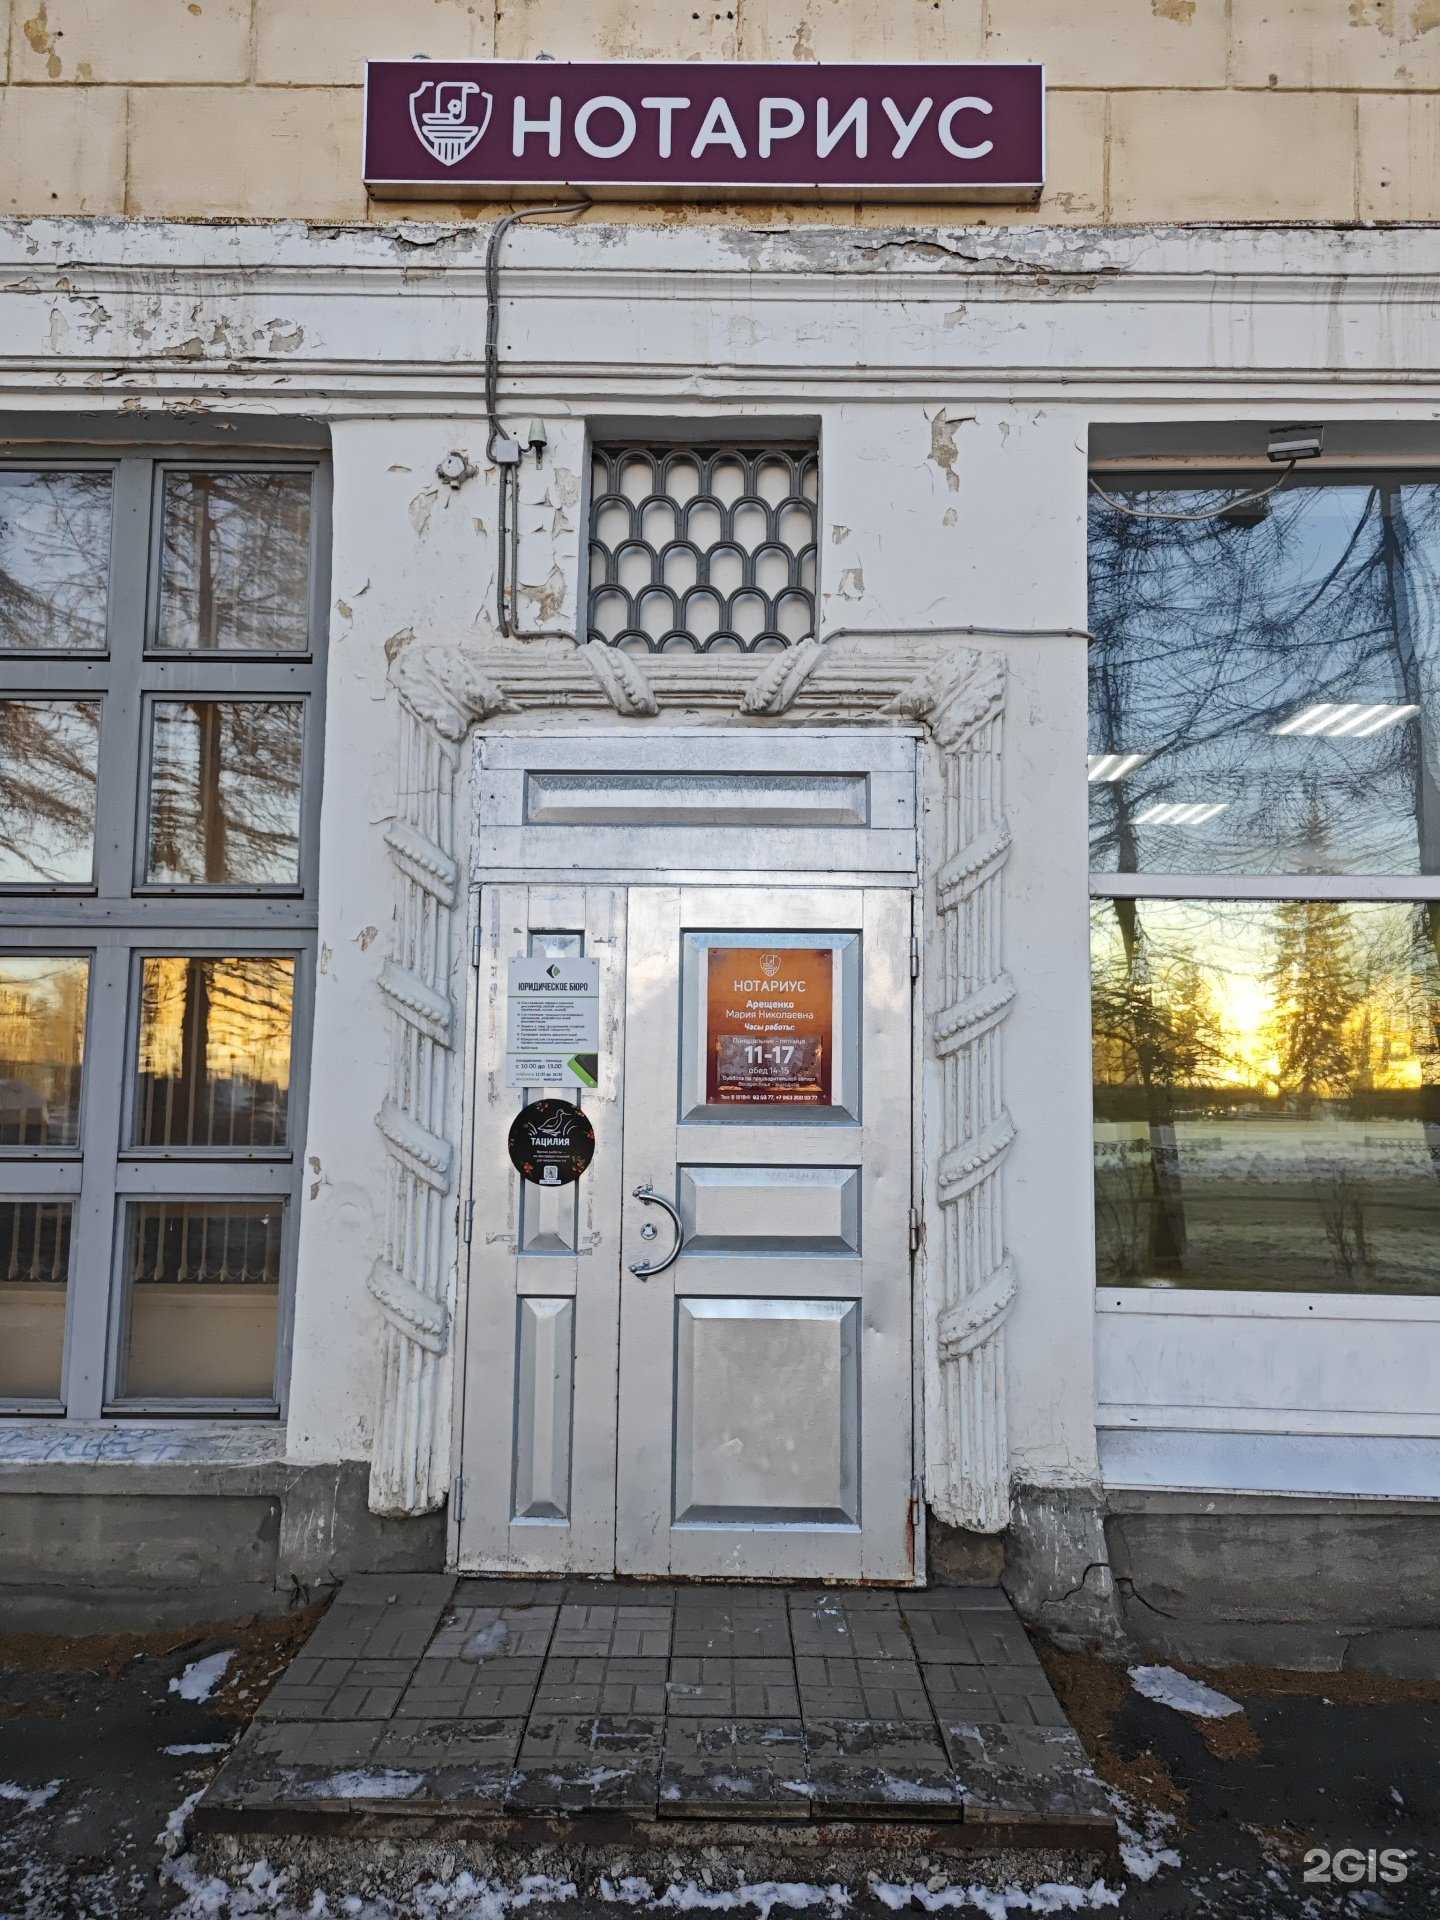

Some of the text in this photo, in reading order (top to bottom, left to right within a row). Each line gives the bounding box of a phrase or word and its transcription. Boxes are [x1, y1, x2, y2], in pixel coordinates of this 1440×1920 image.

[512, 95, 994, 160] НОТАРИУС
[518, 982, 589, 992] ЮРИДИЧЕСКОЕ БЮРО
[734, 980, 807, 993] НОТАРИУС
[745, 1000, 795, 1010] Арещенко
[726, 1009, 814, 1020] Мария Николаевна
[744, 1022, 796, 1033] Часы работы:
[744, 1045, 795, 1064] 11-17
[748, 1066, 769, 1075] обед
[530, 1137, 570, 1147] ТАЦИЛИЯ
